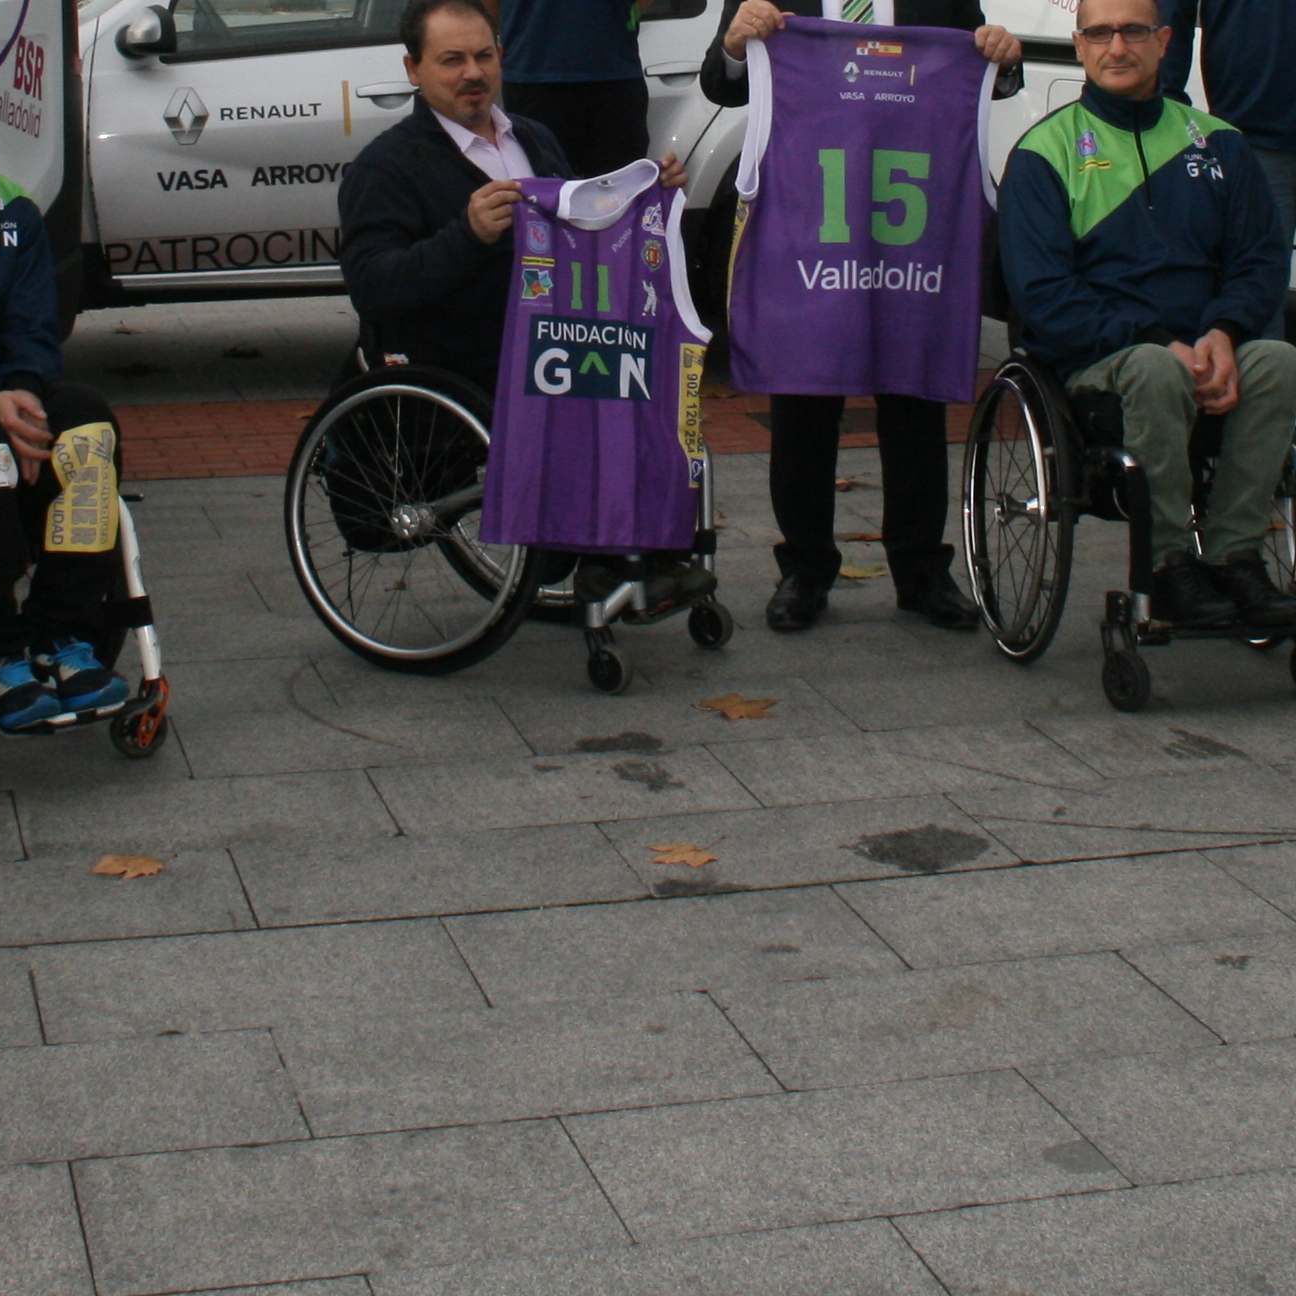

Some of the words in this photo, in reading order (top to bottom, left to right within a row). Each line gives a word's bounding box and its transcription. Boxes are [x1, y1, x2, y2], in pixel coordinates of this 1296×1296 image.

[14, 35, 44, 101] BSR
[863, 69, 904, 78] RENAULT
[839, 91, 866, 101] VASA
[874, 92, 916, 103] ARROYO
[220, 102, 322, 121] RENAULT
[156, 168, 228, 192] VASA
[818, 148, 931, 246] 15
[105, 228, 342, 274] PATROCIN
[570, 261, 611, 312] 11
[797, 259, 943, 293] Valladolid
[686, 373, 698, 397] 902
[685, 403, 697, 426] 120
[684, 430, 696, 453] 254
